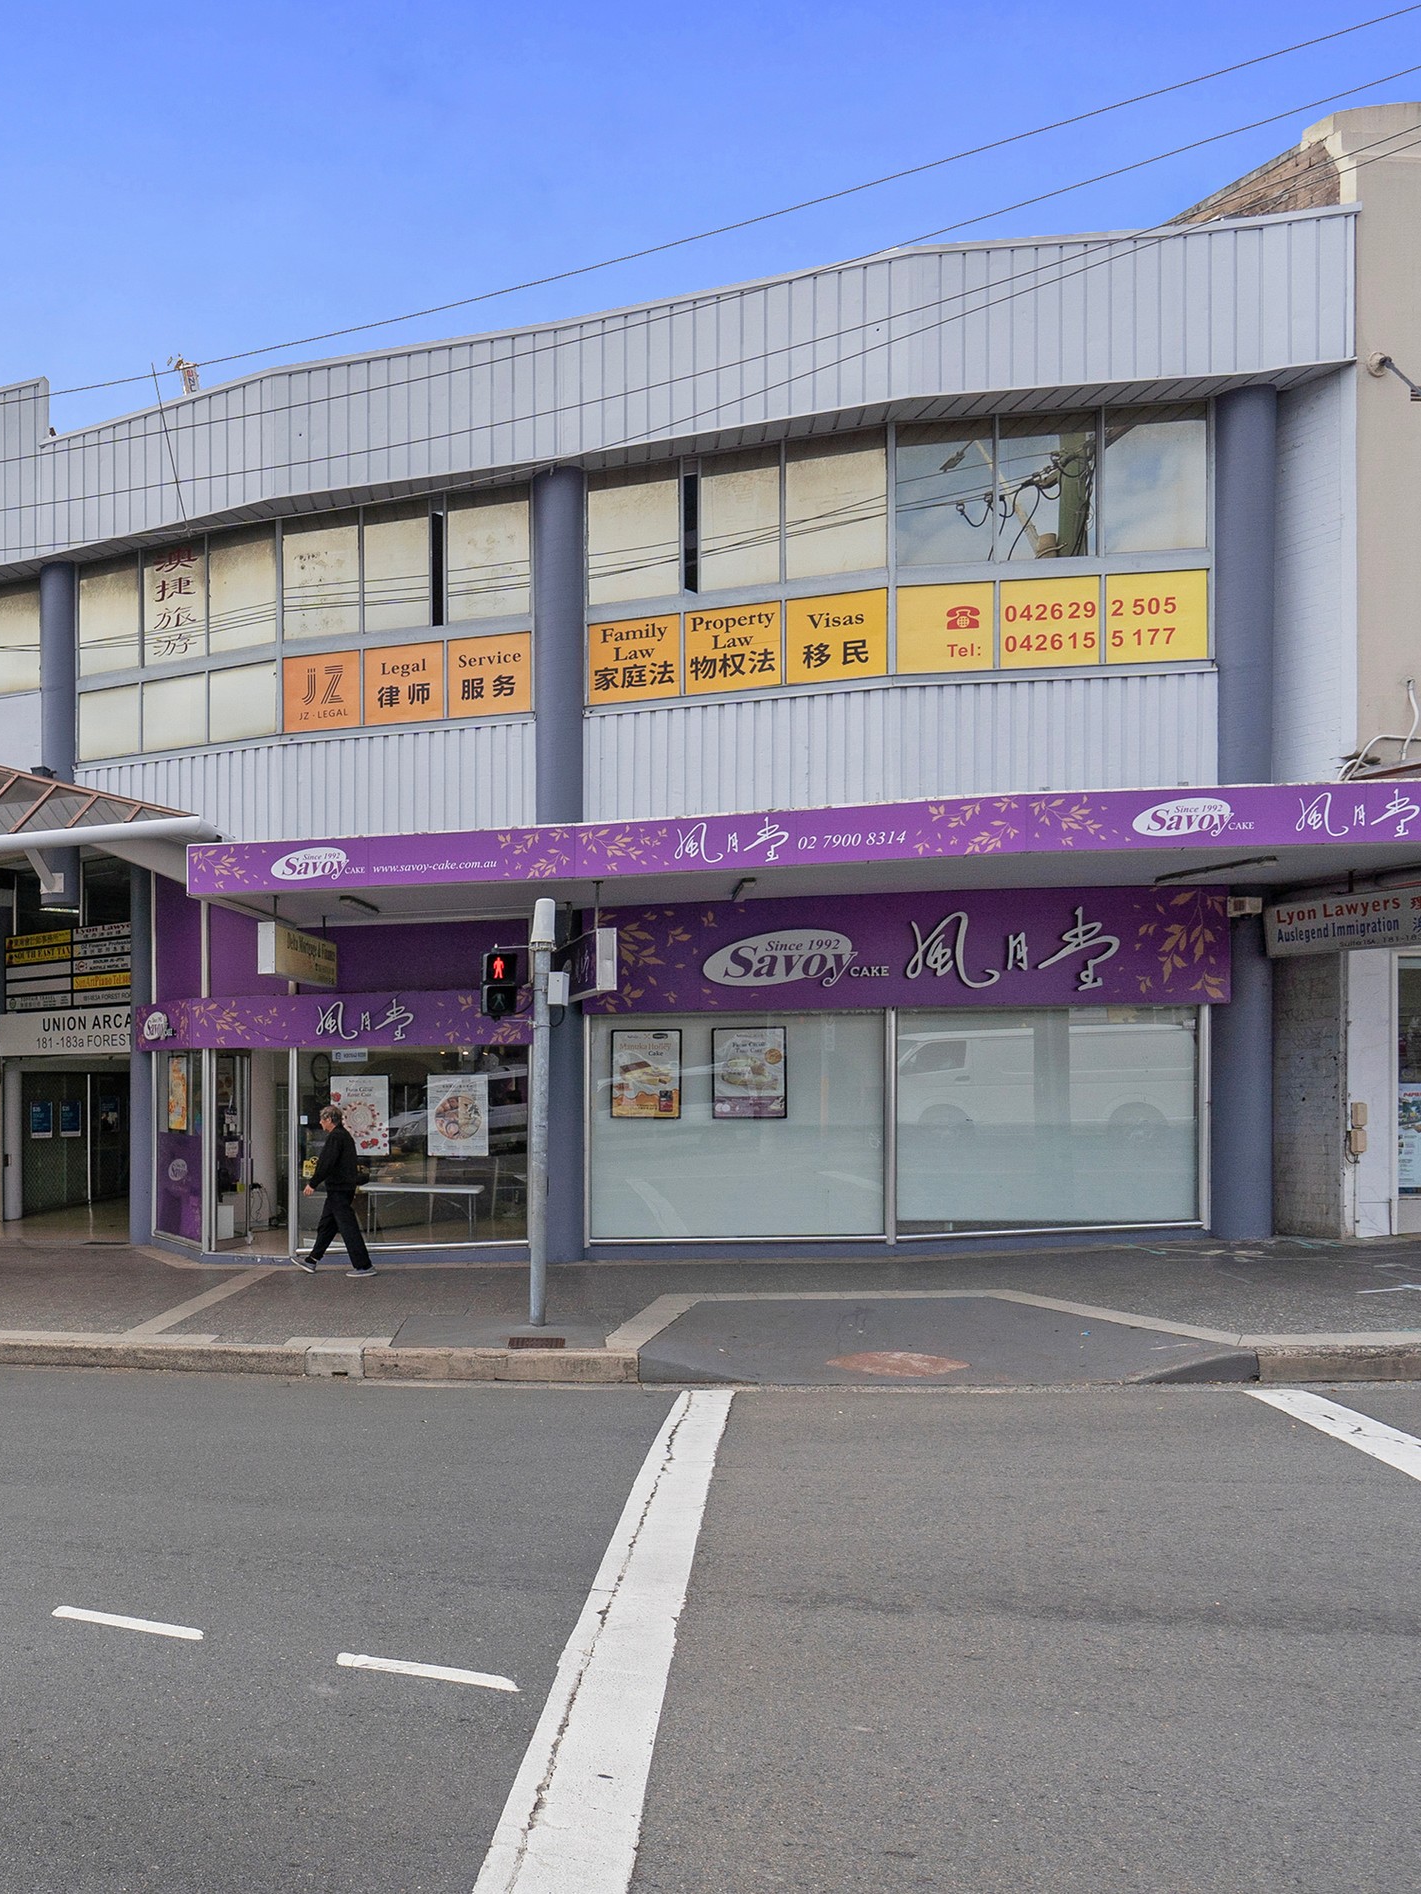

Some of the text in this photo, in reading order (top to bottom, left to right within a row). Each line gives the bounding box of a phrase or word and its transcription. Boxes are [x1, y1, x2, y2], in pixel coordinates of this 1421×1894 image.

[1131, 596, 1178, 616] 505
[689, 609, 774, 637] Property
[807, 609, 865, 629] Visas
[600, 621, 668, 645] Family
[712, 632, 754, 650] Law
[1132, 626, 1178, 646] 177
[457, 649, 522, 669] Service
[613, 645, 656, 662] Law
[802, 639, 870, 669] 移民
[946, 643, 982, 658] Tel:
[380, 658, 427, 679] Legal
[689, 649, 776, 682] 物权法
[301, 665, 344, 706] JZ
[594, 661, 676, 692] 家庭法
[377, 682, 432, 709] 律师
[460, 674, 517, 702] 服务
[299, 707, 348, 721] JZ LEGAL
[1174, 803, 1224, 813] Since 1992
[1146, 808, 1255, 837] Savoy CAKE
[797, 830, 907, 850] 02 7900 8314
[303, 853, 322, 861] Since
[372, 859, 498, 874] www.savoy-cake.com.au
[282, 857, 366, 881] Savoy CAKE
[1276, 908, 1317, 926] Lyon
[1322, 897, 1401, 918] Lawyers
[74, 926, 98, 935] Lyon
[1277, 923, 1329, 943] Auslegend
[1332, 917, 1400, 938] Immigration
[14, 949, 39, 960] SOUTH
[39, 948, 56, 958] EAST
[57, 947, 71, 956] TAX
[765, 938, 841, 951] Since 1992
[723, 945, 890, 987] Savoy CAKE
[42, 1015, 87, 1032] UNION
[619, 1042, 672, 1050] Manuka Honey
